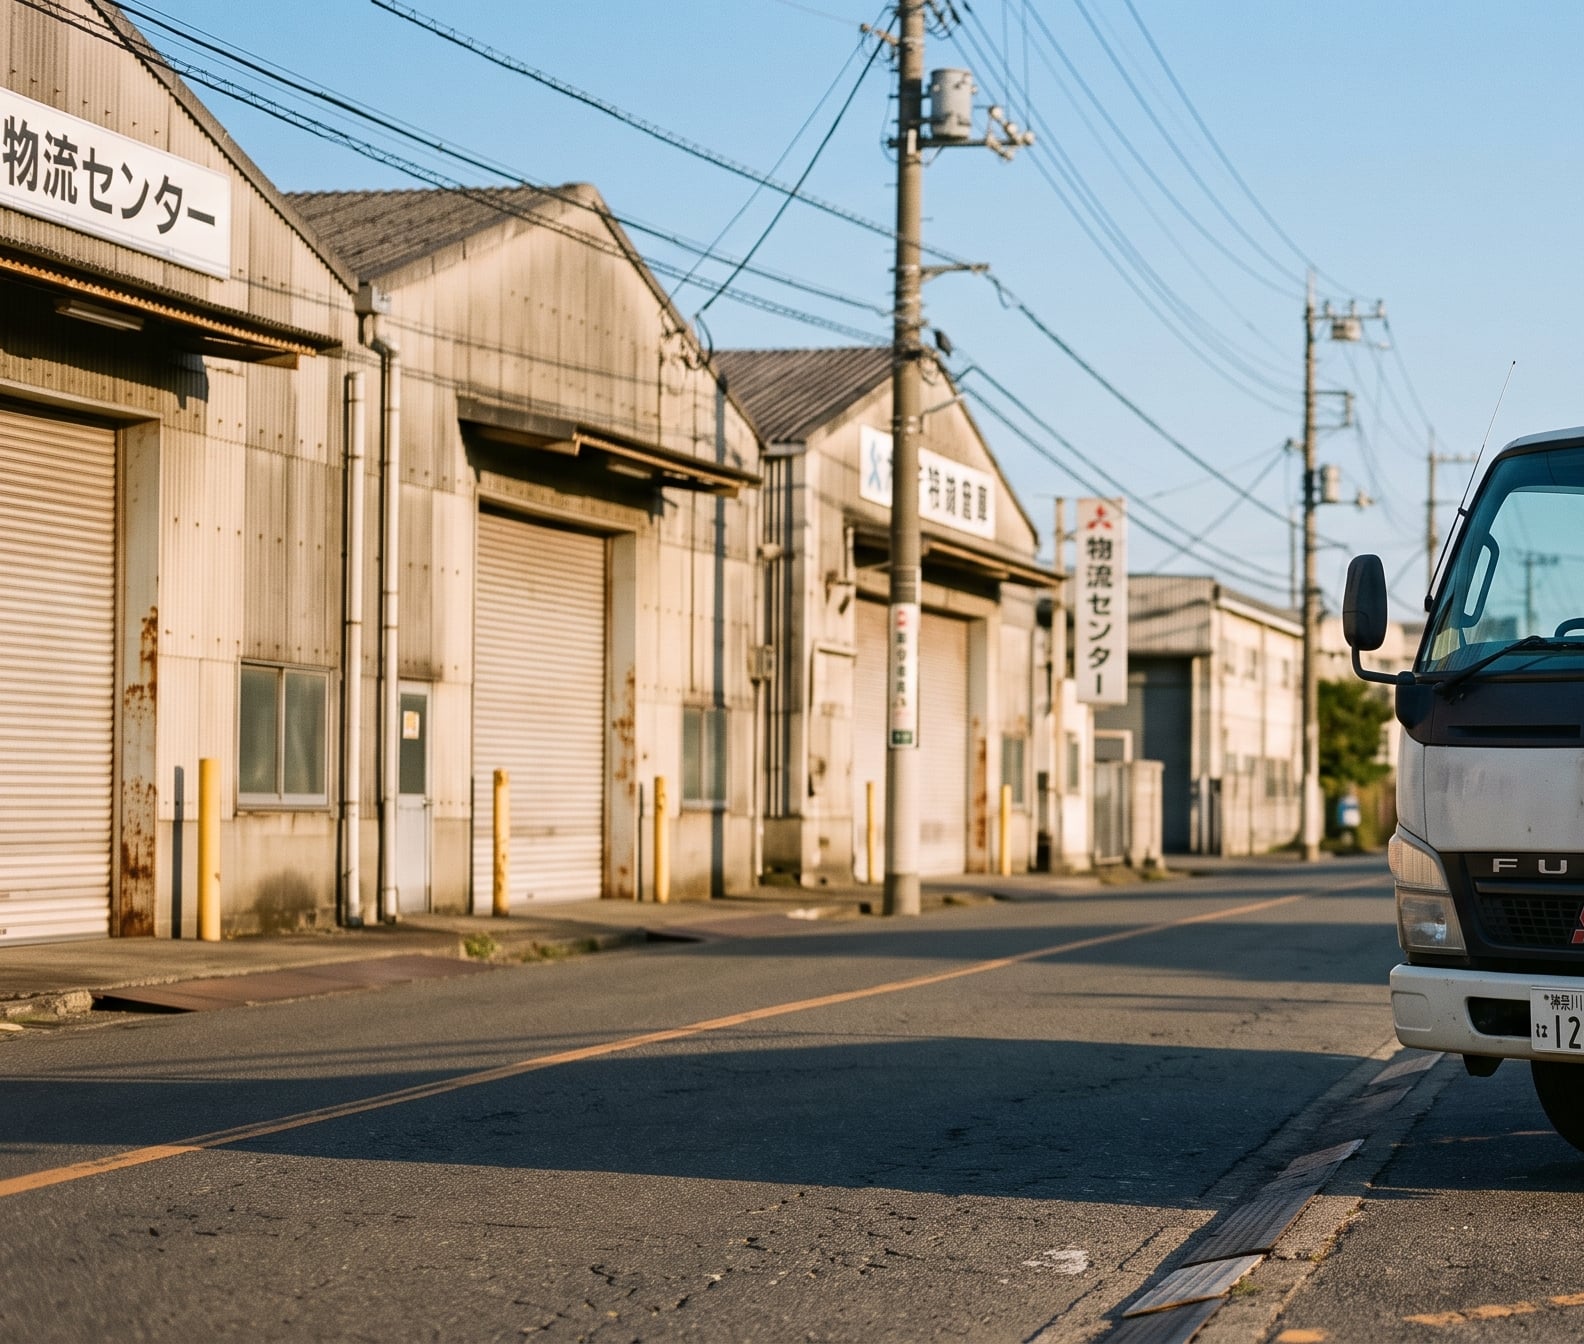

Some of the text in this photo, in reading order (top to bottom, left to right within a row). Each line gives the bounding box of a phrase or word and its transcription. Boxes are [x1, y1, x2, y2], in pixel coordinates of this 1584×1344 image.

[2, 115, 216, 235] 物流センター
[1086, 536, 1113, 697] 物流センター
